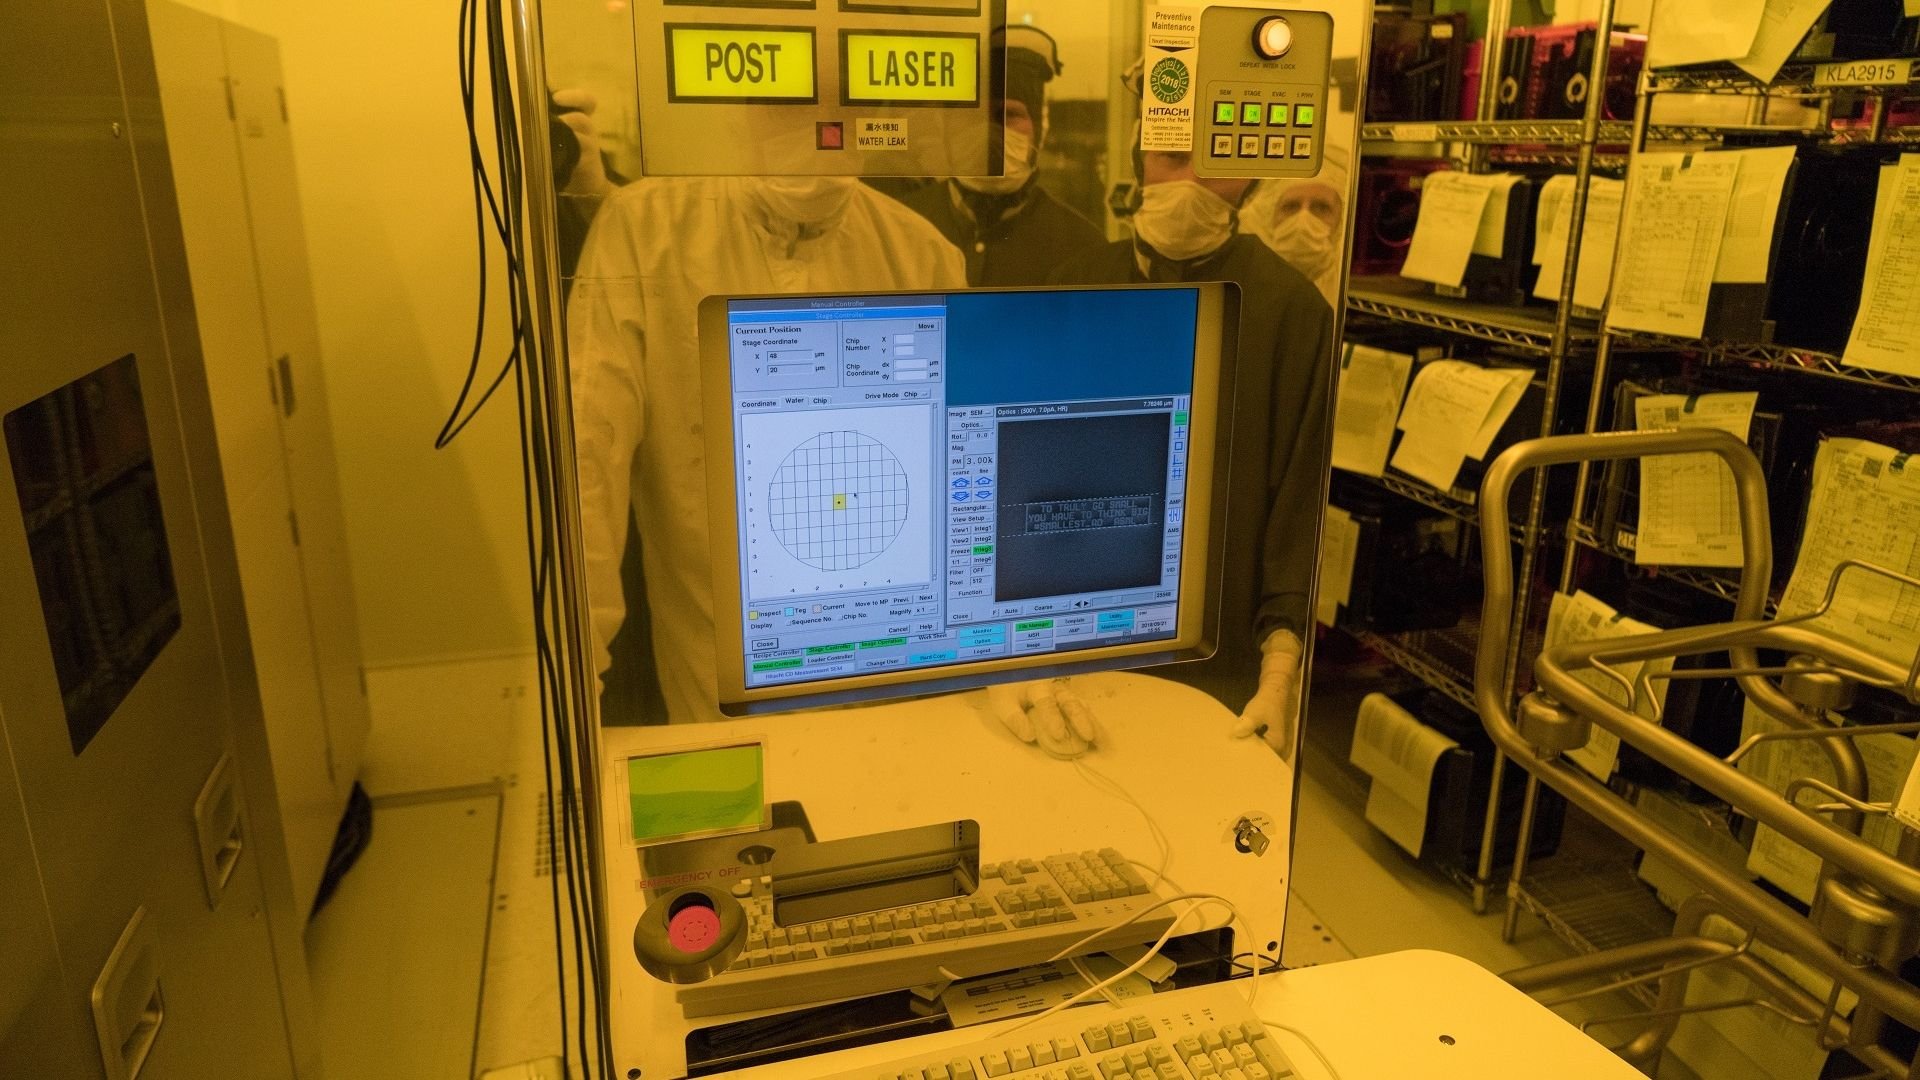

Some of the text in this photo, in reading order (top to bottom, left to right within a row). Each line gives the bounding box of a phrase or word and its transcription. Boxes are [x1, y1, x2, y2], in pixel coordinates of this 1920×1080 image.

[1155, 11, 1192, 21] Preventive
[1151, 21, 1195, 32] Maintenance
[706, 42, 781, 83] POST
[868, 50, 955, 87] LASER
[1826, 64, 1896, 82] KLA2915
[1160, 74, 1179, 89] 2018
[1148, 107, 1189, 116] HITACHI
[858, 137, 906, 146] WATER LEAK
[735, 325, 802, 335] Current Position
[742, 338, 798, 348] Stage Coordinate
[845, 344, 871, 352] Number
[997, 408, 1016, 416] Optics
[1041, 504, 1052, 513] TO
[1059, 502, 1087, 511] TRULY
[1110, 500, 1137, 509] SMALL
[1029, 513, 1046, 523] YOU
[1052, 512, 1076, 521] HAVE
[1082, 510, 1092, 519] TO
[1099, 508, 1128, 518] THINK
[1114, 517, 1136, 525] ASML
[974, 535, 992, 543] Integ2
[958, 589, 983, 597] Function
[758, 610, 782, 618] Inspect
[822, 603, 845, 611] Current
[791, 617, 822, 626] Sequence
[640, 866, 742, 889] EMERGENCY OFF
